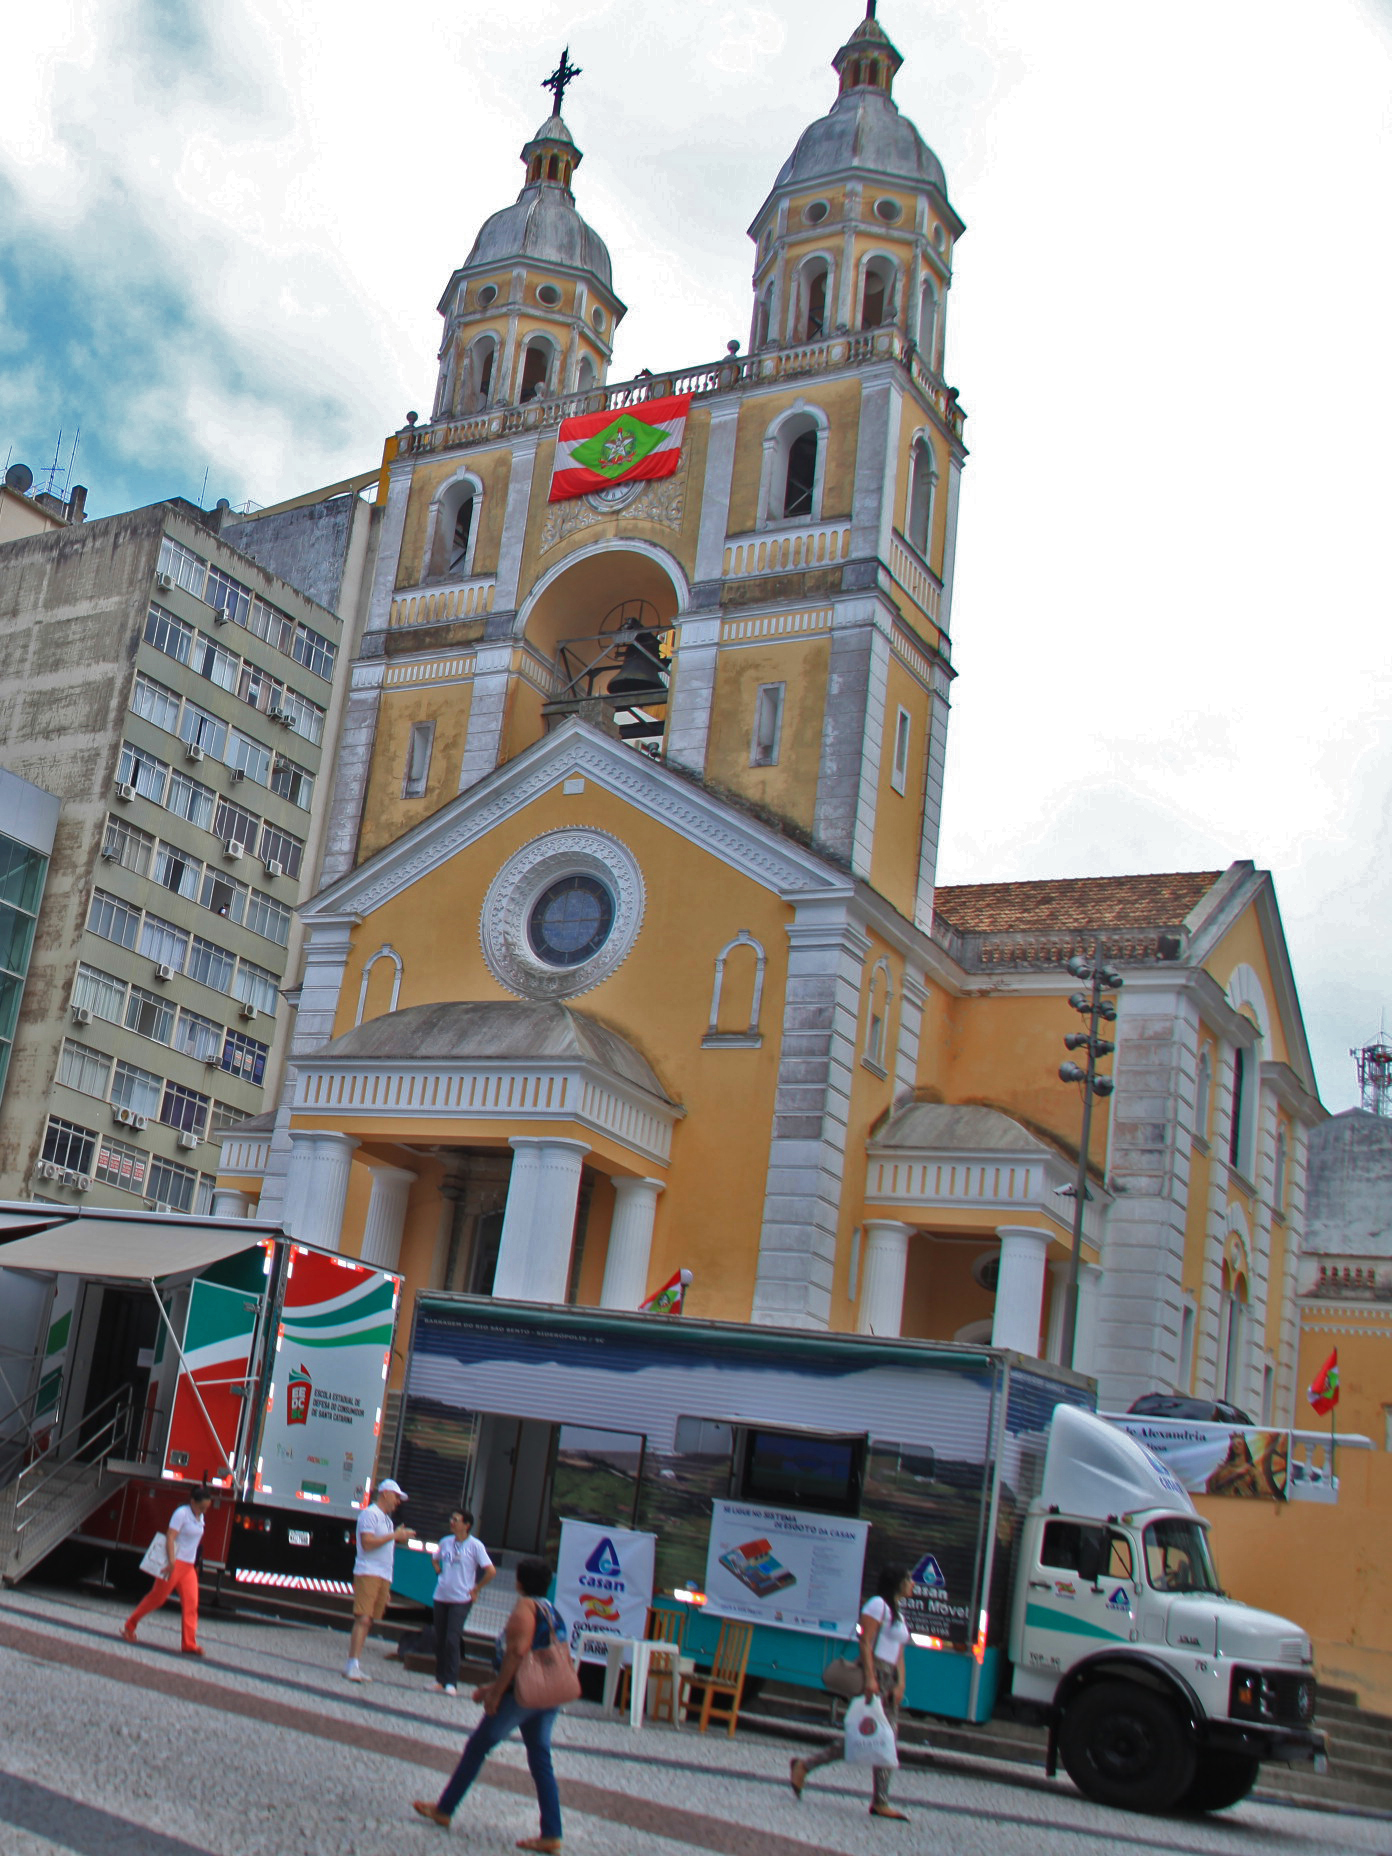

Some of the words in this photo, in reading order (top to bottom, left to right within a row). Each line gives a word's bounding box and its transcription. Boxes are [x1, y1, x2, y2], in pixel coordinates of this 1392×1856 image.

[475, 1323, 489, 1331] RIO
[506, 1327, 530, 1335] BENTO
[314, 1388, 331, 1400] ESCOLA
[332, 1392, 354, 1405] ESTADUAL
[354, 1397, 361, 1407] DE
[313, 1398, 330, 1409] DEFESA
[330, 1402, 337, 1411] DO
[337, 1404, 365, 1417] CONSUMIDOR
[311, 1408, 317, 1417] DE
[318, 1409, 333, 1420] SANTA
[333, 1413, 353, 1425] CATARINA
[1141, 1427, 1207, 1443] Alexandria
[752, 1509, 763, 1518] NO
[763, 1510, 797, 1522] SISTEMA
[774, 1521, 783, 1529] DE
[784, 1522, 817, 1534] ESGOTO
[818, 1527, 828, 1536] DA
[830, 1530, 856, 1540] CASAN
[578, 1574, 625, 1593] casan
[911, 1584, 948, 1601] asan
